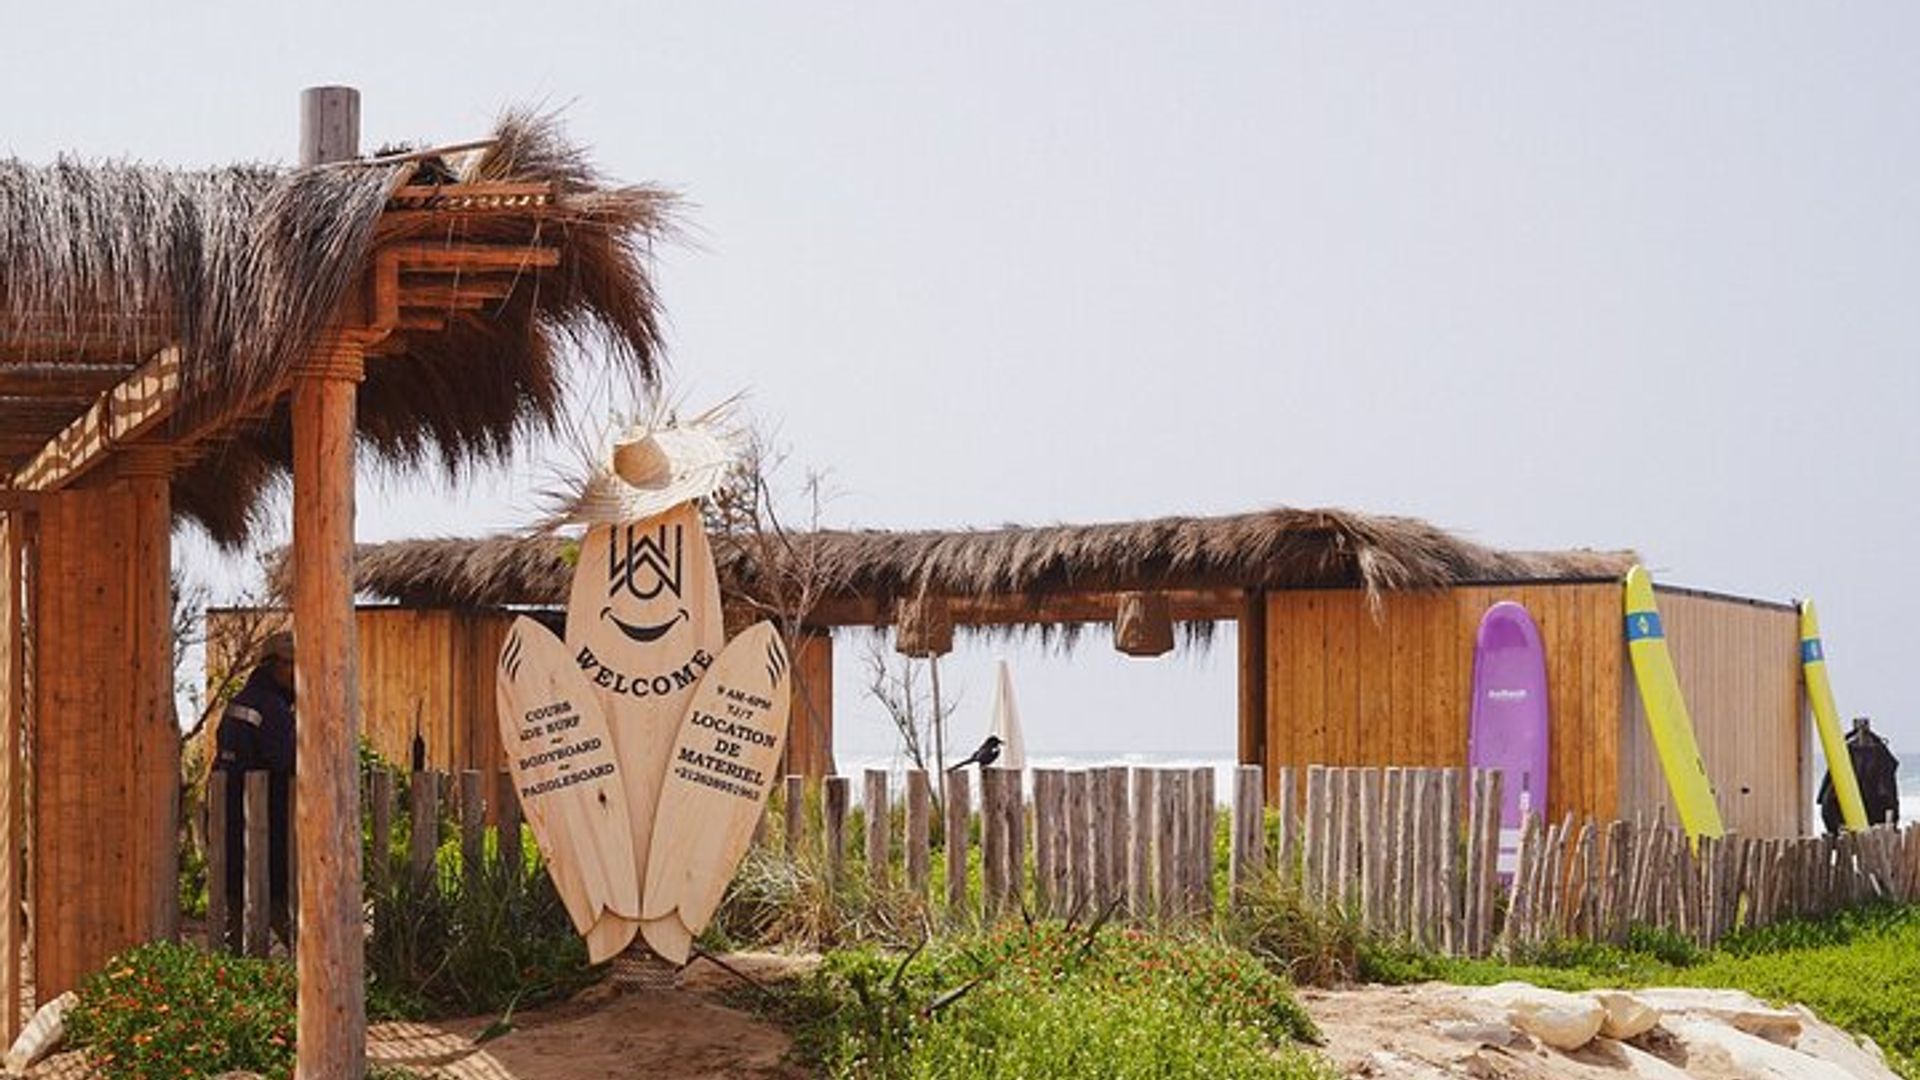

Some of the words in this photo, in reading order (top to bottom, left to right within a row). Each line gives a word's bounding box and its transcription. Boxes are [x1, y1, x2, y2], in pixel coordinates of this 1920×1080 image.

[575, 647, 714, 698] WELCOME
[525, 700, 572, 722] COURS
[546, 715, 580, 733] SURF
[691, 711, 777, 748] LOCATION
[520, 738, 602, 771] BODYBOARD
[714, 738, 741, 757] DE
[521, 763, 615, 798] PADDLEBOARD
[677, 747, 764, 786] MATERIEL
